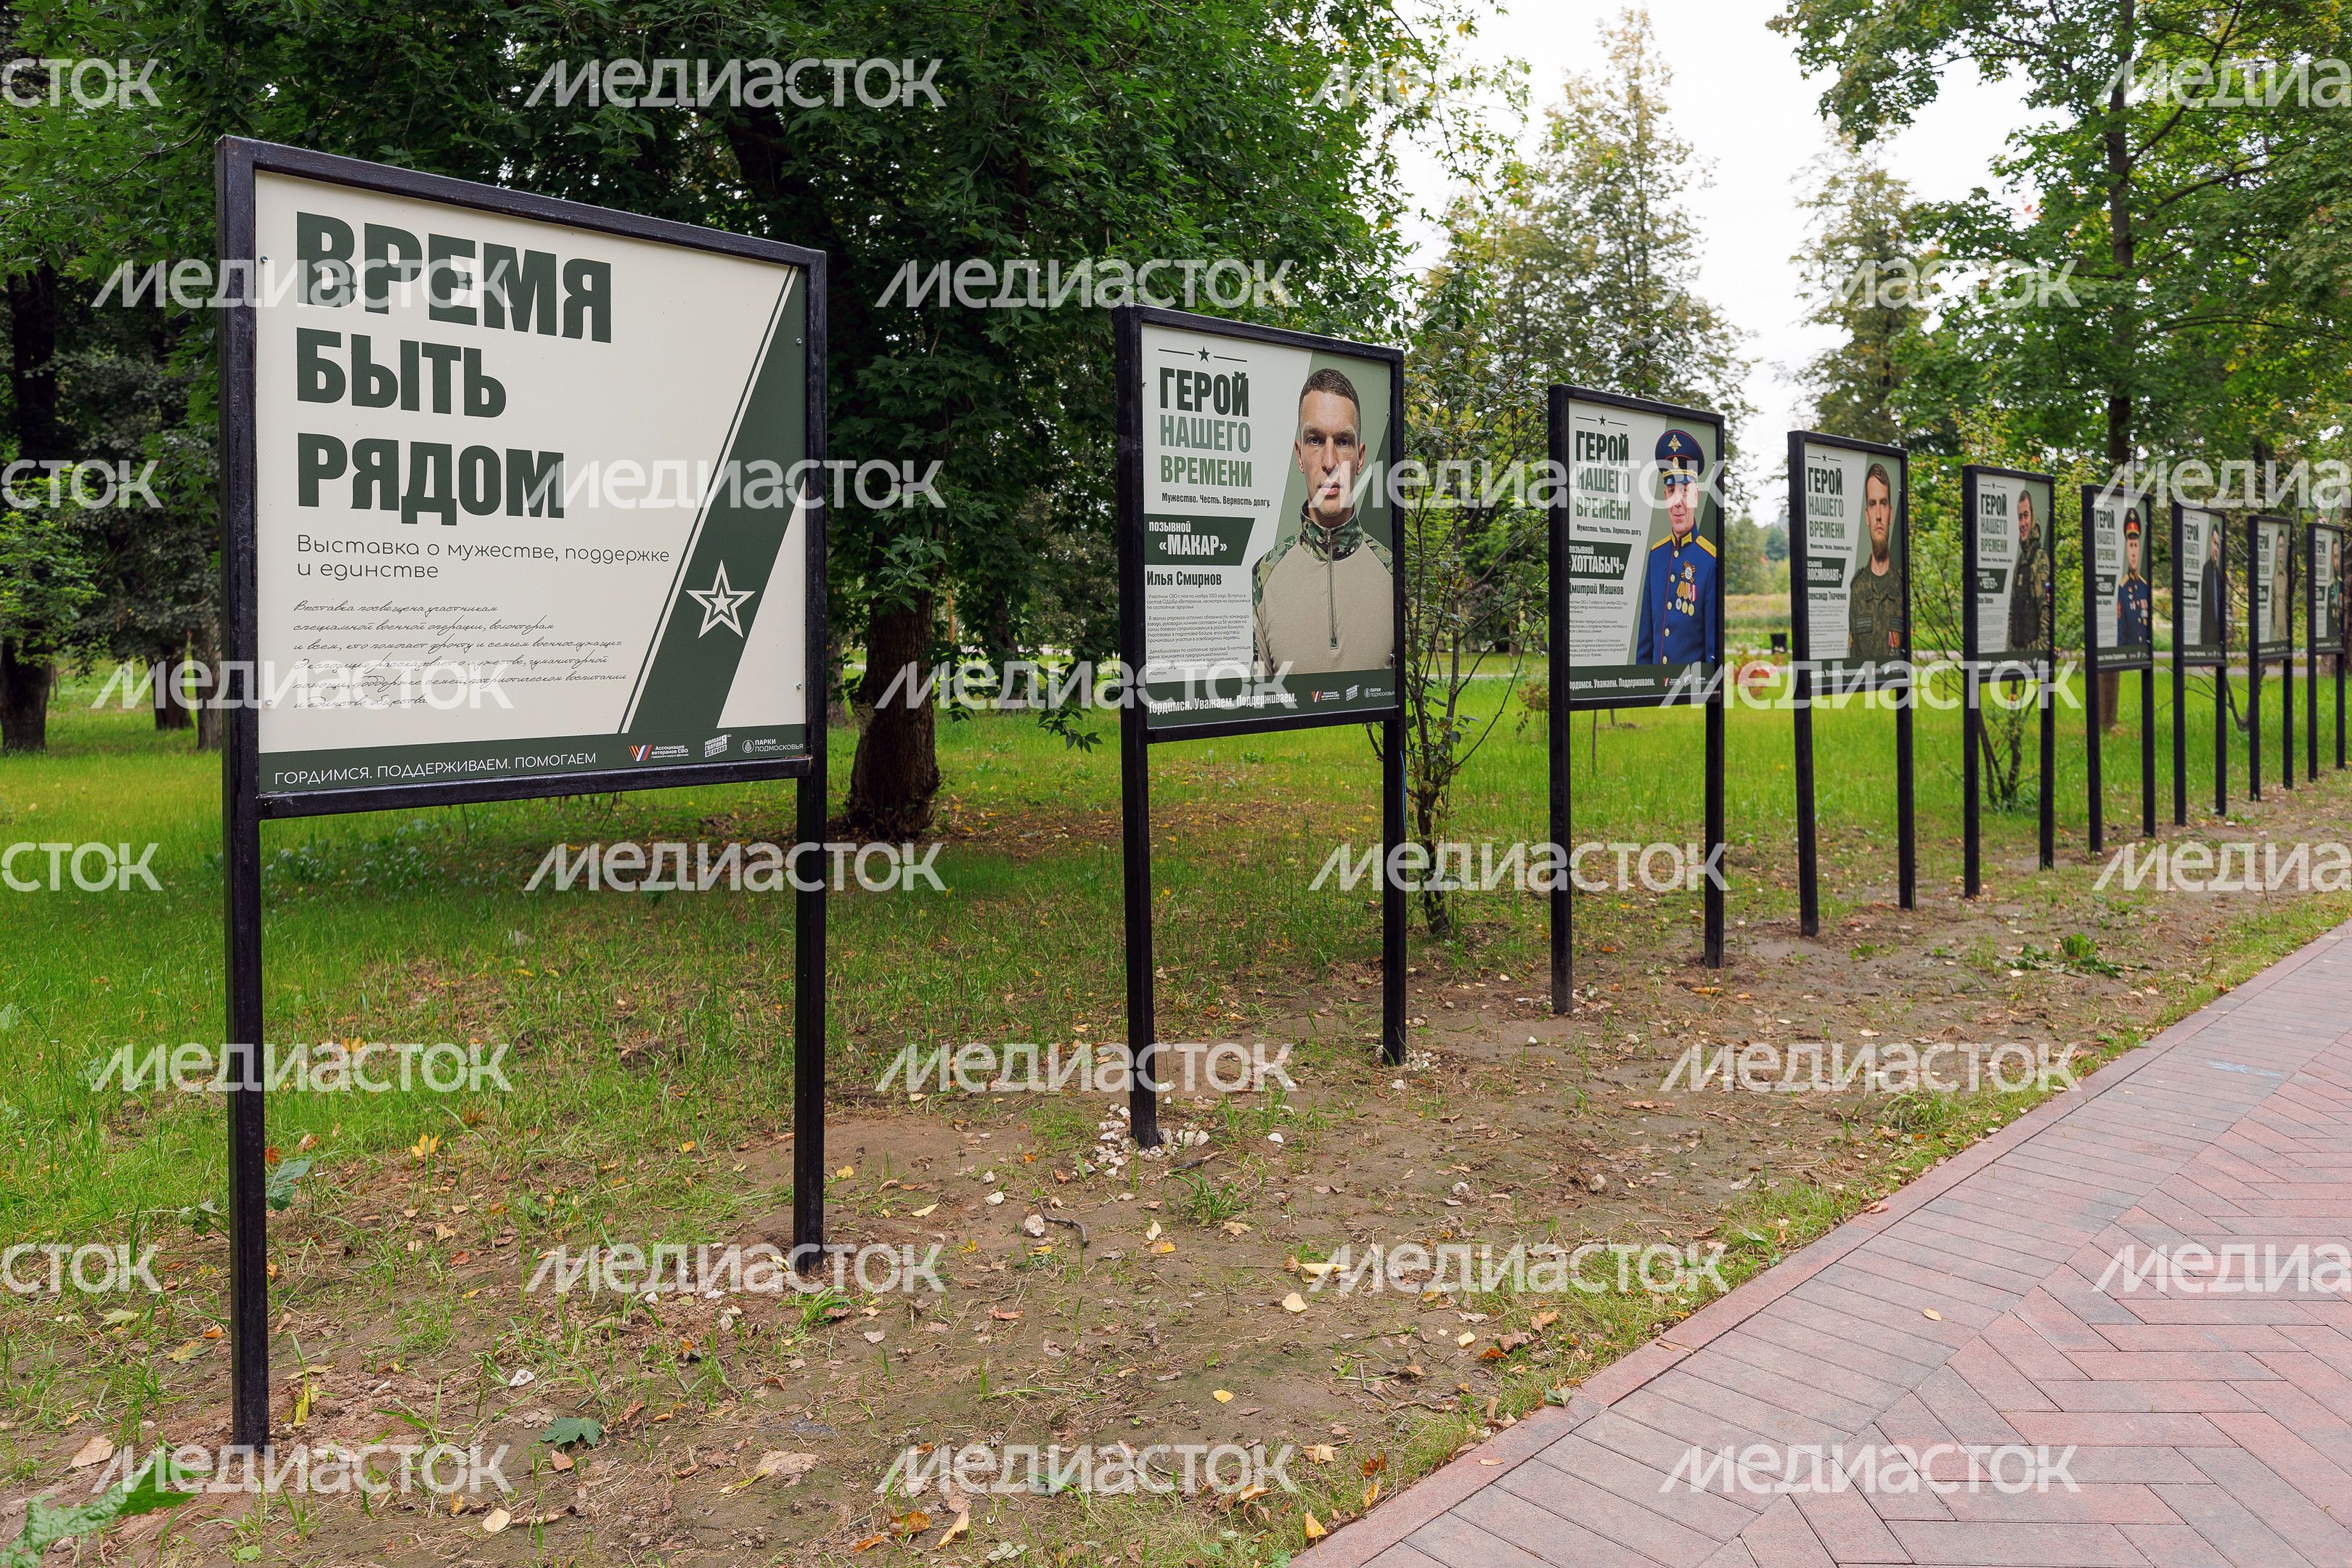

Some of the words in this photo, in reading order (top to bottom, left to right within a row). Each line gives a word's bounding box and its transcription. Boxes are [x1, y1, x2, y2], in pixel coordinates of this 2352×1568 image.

[297, 211, 611, 343] ВРЕМЯ
[297, 327, 507, 418] БЫТЬ
[1159, 367, 1249, 417] ГЕРОЙ
[1160, 415, 1251, 454] НАШЕГО
[1576, 430, 1629, 467] ГЕРОЙ
[298, 432, 564, 526] РЯДОМ
[1161, 454, 1252, 488] ВРЕМЕНИ
[1576, 466, 1630, 495] НАШЕГО
[1808, 467, 1842, 496] ГЕРОЙ
[1161, 492, 1199, 503] Мужество.
[1199, 494, 1222, 505] Честь.
[1222, 496, 1252, 507] Верность
[1253, 499, 1271, 508] долгу.
[1576, 496, 1630, 521] ВРЕМЕНИ
[1808, 495, 1844, 518] НАШЕГО
[1980, 493, 2007, 516] ГЕРОЙ
[1148, 520, 1191, 533] позывной
[1809, 520, 1845, 539] ВРЕМЕНИ
[1980, 517, 2008, 535] НАШЕГО
[297, 534, 419, 555] Выставка
[427, 543, 440, 556] о
[448, 542, 559, 562] мужестве,
[565, 547, 670, 565] поддержке
[1159, 534, 1228, 556] «МАКАР»
[1981, 538, 2008, 553] ВРЕМЕНИ
[297, 563, 311, 576] и
[319, 563, 438, 581] единстве
[1146, 571, 1173, 586] Илья
[1176, 571, 1222, 588] Смирнов
[1598, 584, 1624, 595] Машков
[1569, 679, 1593, 691] ордимся.
[1593, 679, 1618, 689] Уважаем.
[1148, 700, 1193, 714] Гордимся.
[1194, 696, 1235, 711] Уважаем.
[1236, 693, 1297, 709] Поддерживаем.
[755, 743, 804, 752] ПОДМОСКОВЬЯ
[274, 767, 373, 785] ГОРДИМСЯ.
[377, 757, 512, 780] ПОДДЕРЖИВАЕМ.
[515, 752, 597, 769] ПОМОГАЕМ
